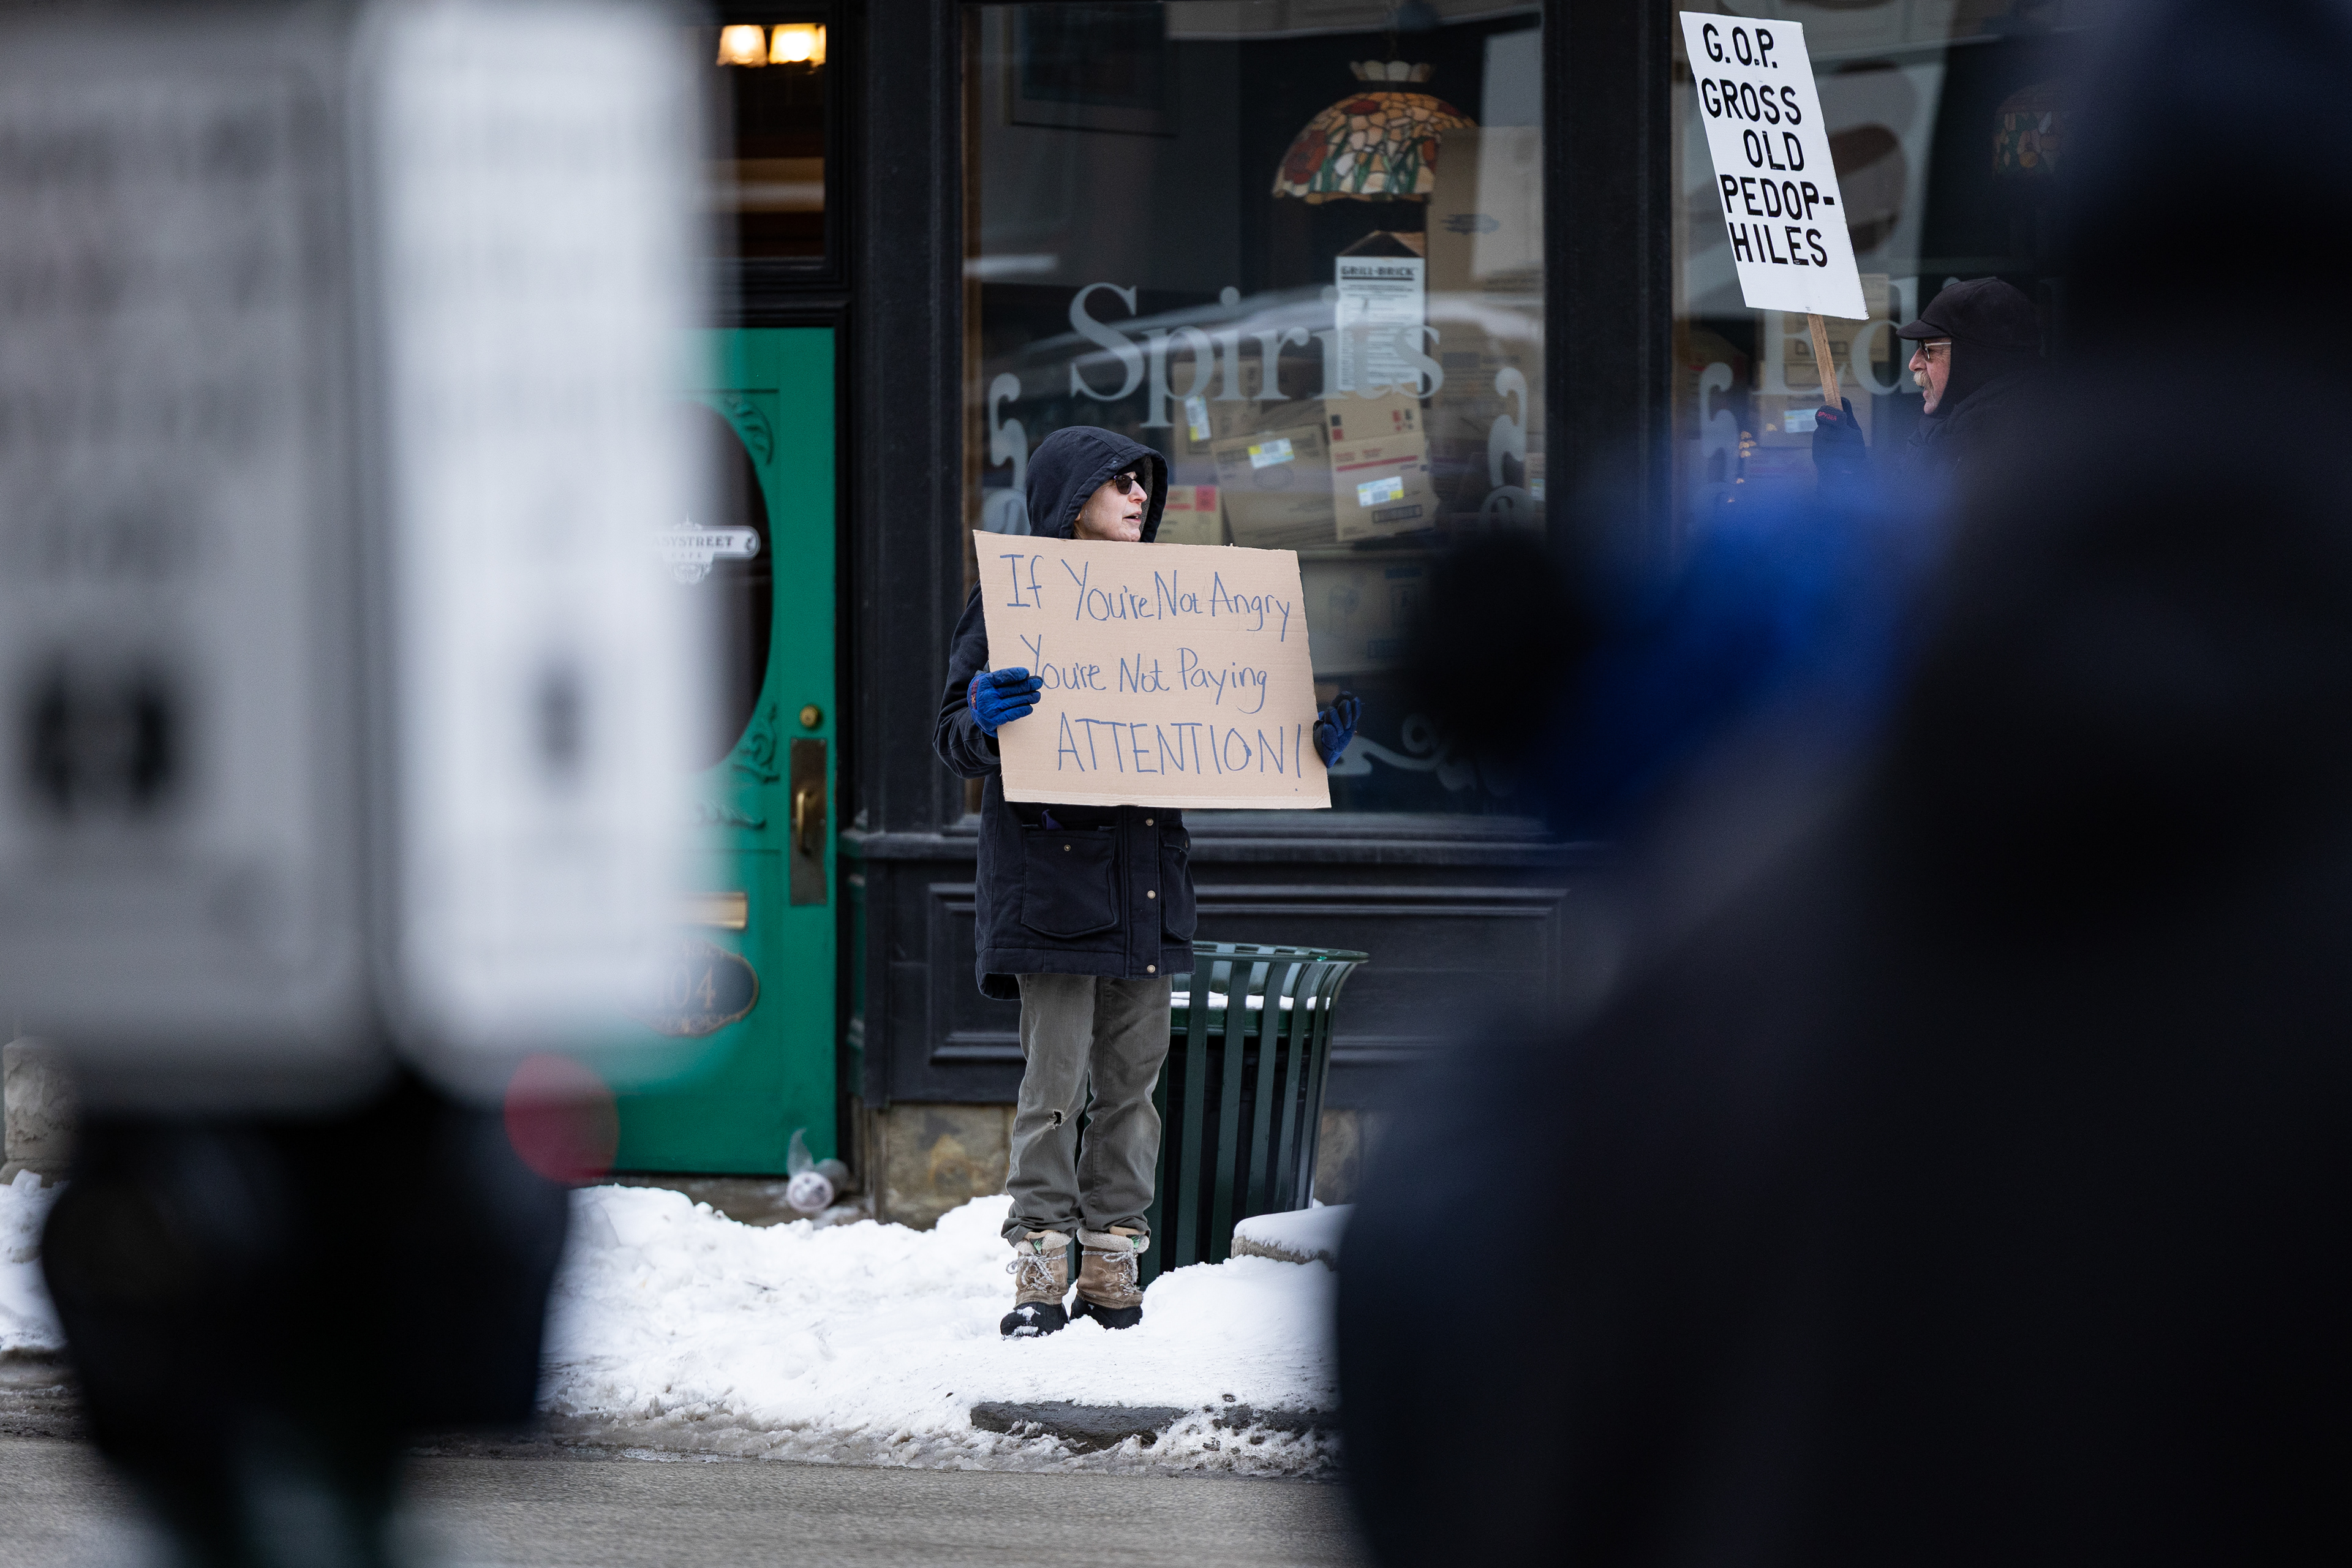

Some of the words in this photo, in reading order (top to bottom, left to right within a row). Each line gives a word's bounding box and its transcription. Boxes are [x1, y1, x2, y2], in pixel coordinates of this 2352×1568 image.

[1702, 23, 1778, 69] G.O.P.
[1701, 77, 1803, 126] GROSS
[1743, 128, 1804, 172] OLD
[1719, 173, 1835, 221] PEDOP-
[1728, 221, 1828, 268] HILES
[1068, 282, 1444, 428] Spirits
[1000, 554, 1044, 609] If
[1153, 570, 1202, 620] Not
[1208, 571, 1291, 642] Angry
[1118, 653, 1169, 693] Not
[1177, 647, 1267, 714] Paying
[1057, 712, 1302, 792] ATTENTION!
